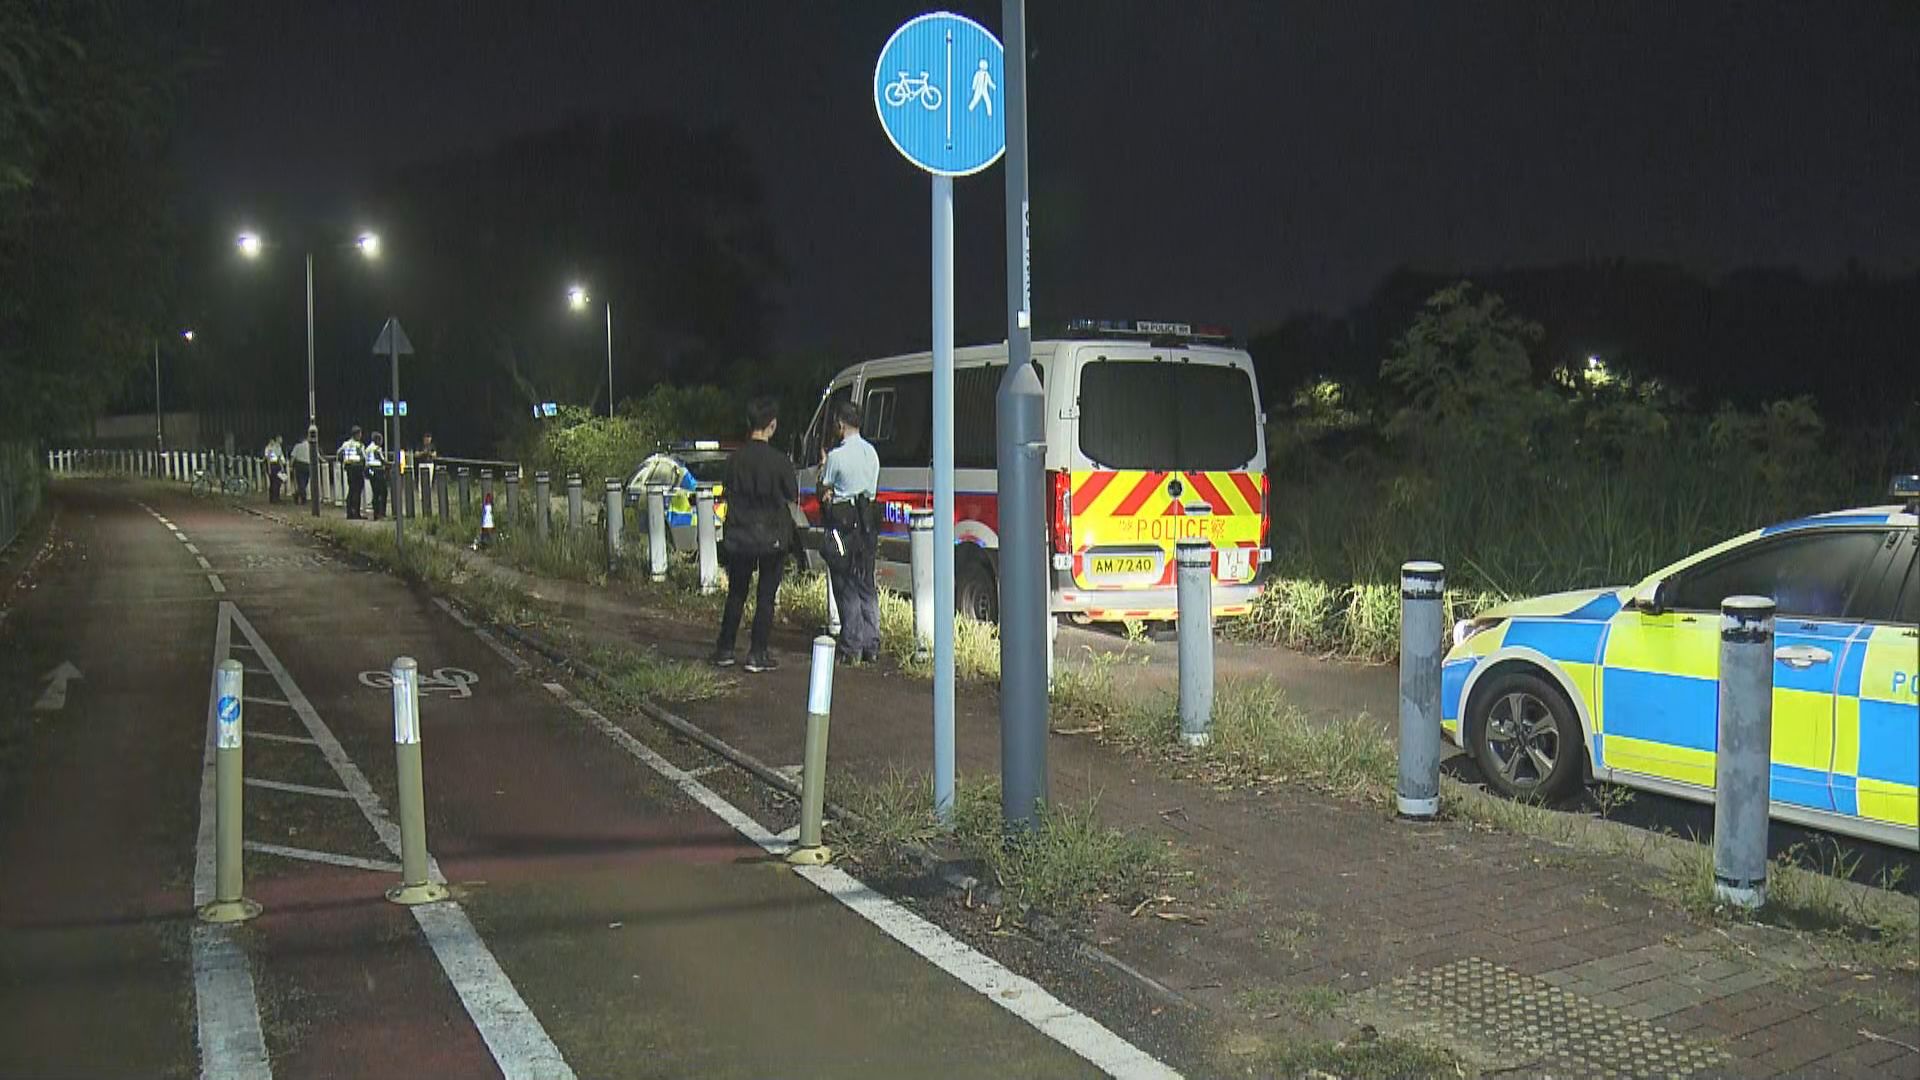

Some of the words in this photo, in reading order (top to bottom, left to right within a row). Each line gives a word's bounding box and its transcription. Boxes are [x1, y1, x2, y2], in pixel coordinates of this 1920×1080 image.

[1136, 518, 1209, 541] POLICE
[1096, 561, 1113, 573] AM
[1117, 558, 1152, 573] 7240
[1226, 552, 1244, 565] YL
[1230, 566, 1238, 578] 2
